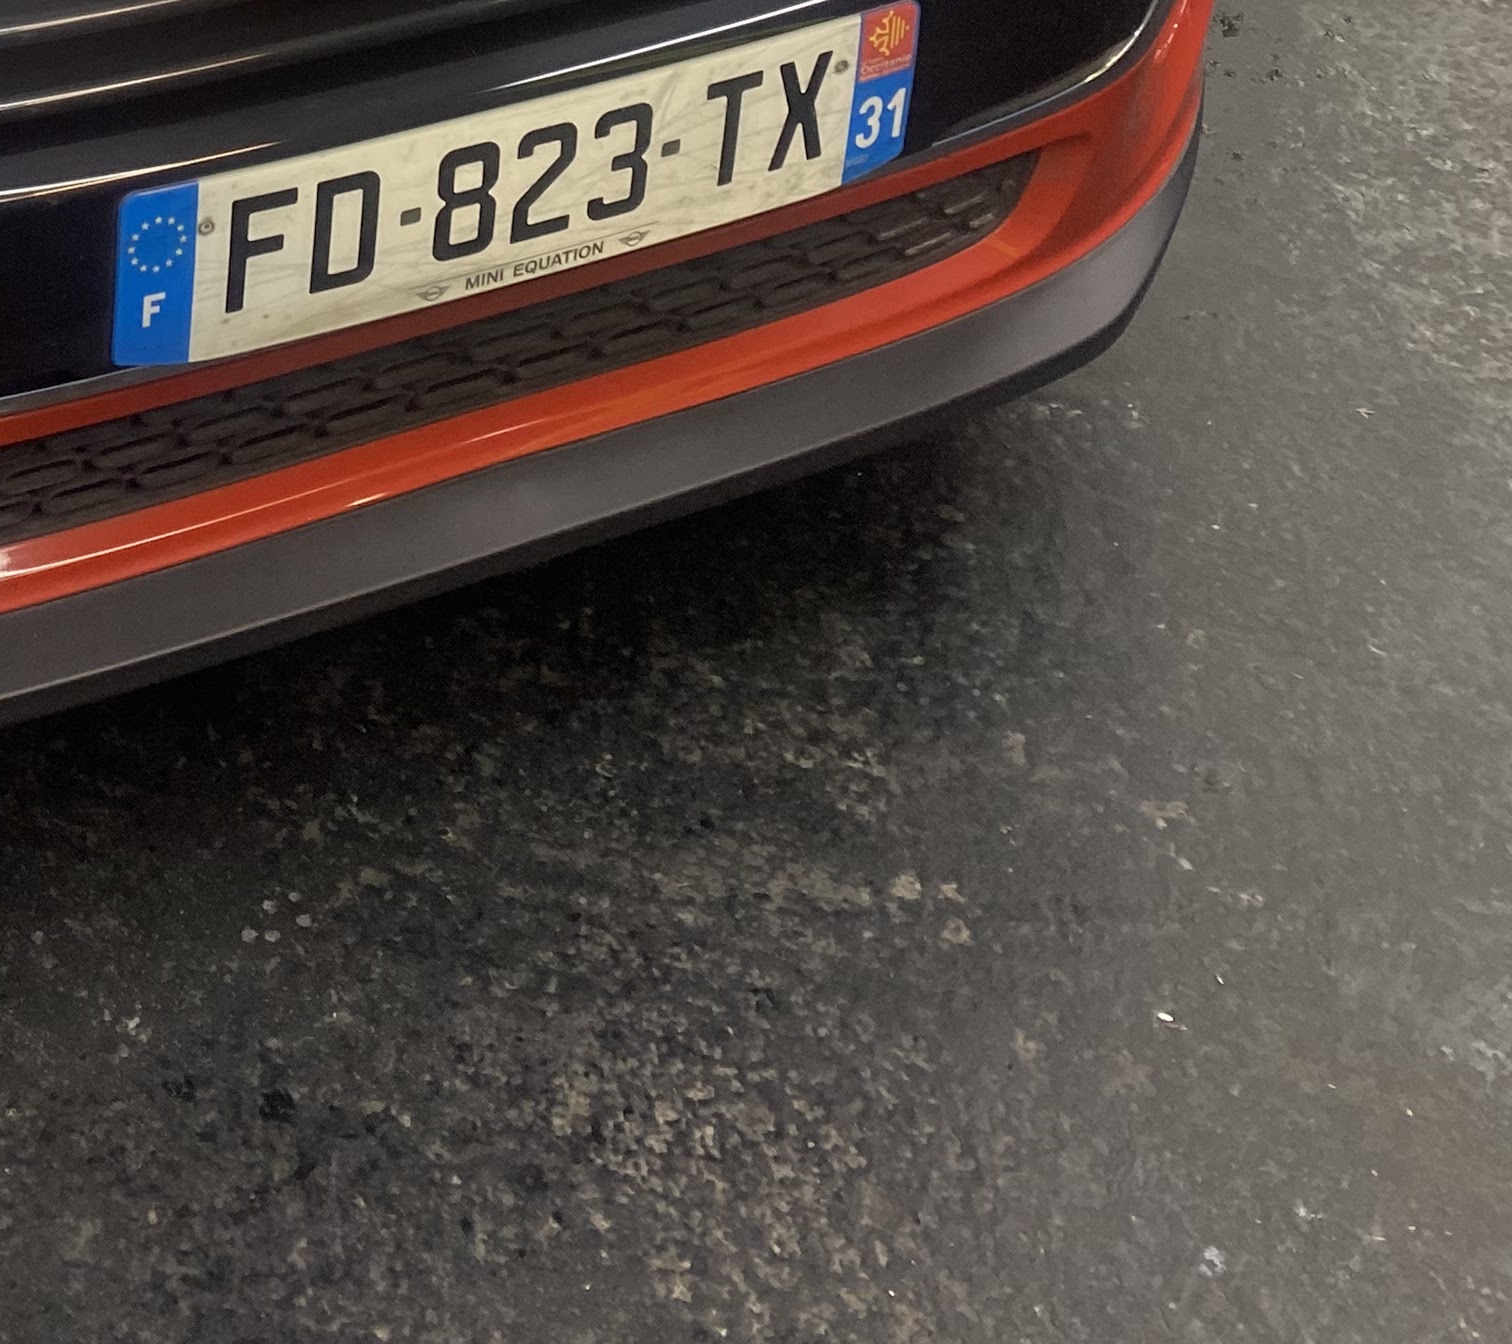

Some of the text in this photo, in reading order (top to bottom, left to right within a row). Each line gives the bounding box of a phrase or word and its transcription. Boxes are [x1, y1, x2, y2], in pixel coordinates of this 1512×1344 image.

[855, 88, 907, 149] 31
[225, 51, 833, 313] FD-823-TX
[465, 241, 605, 291] MINI EQUATION
[142, 292, 166, 328] F
